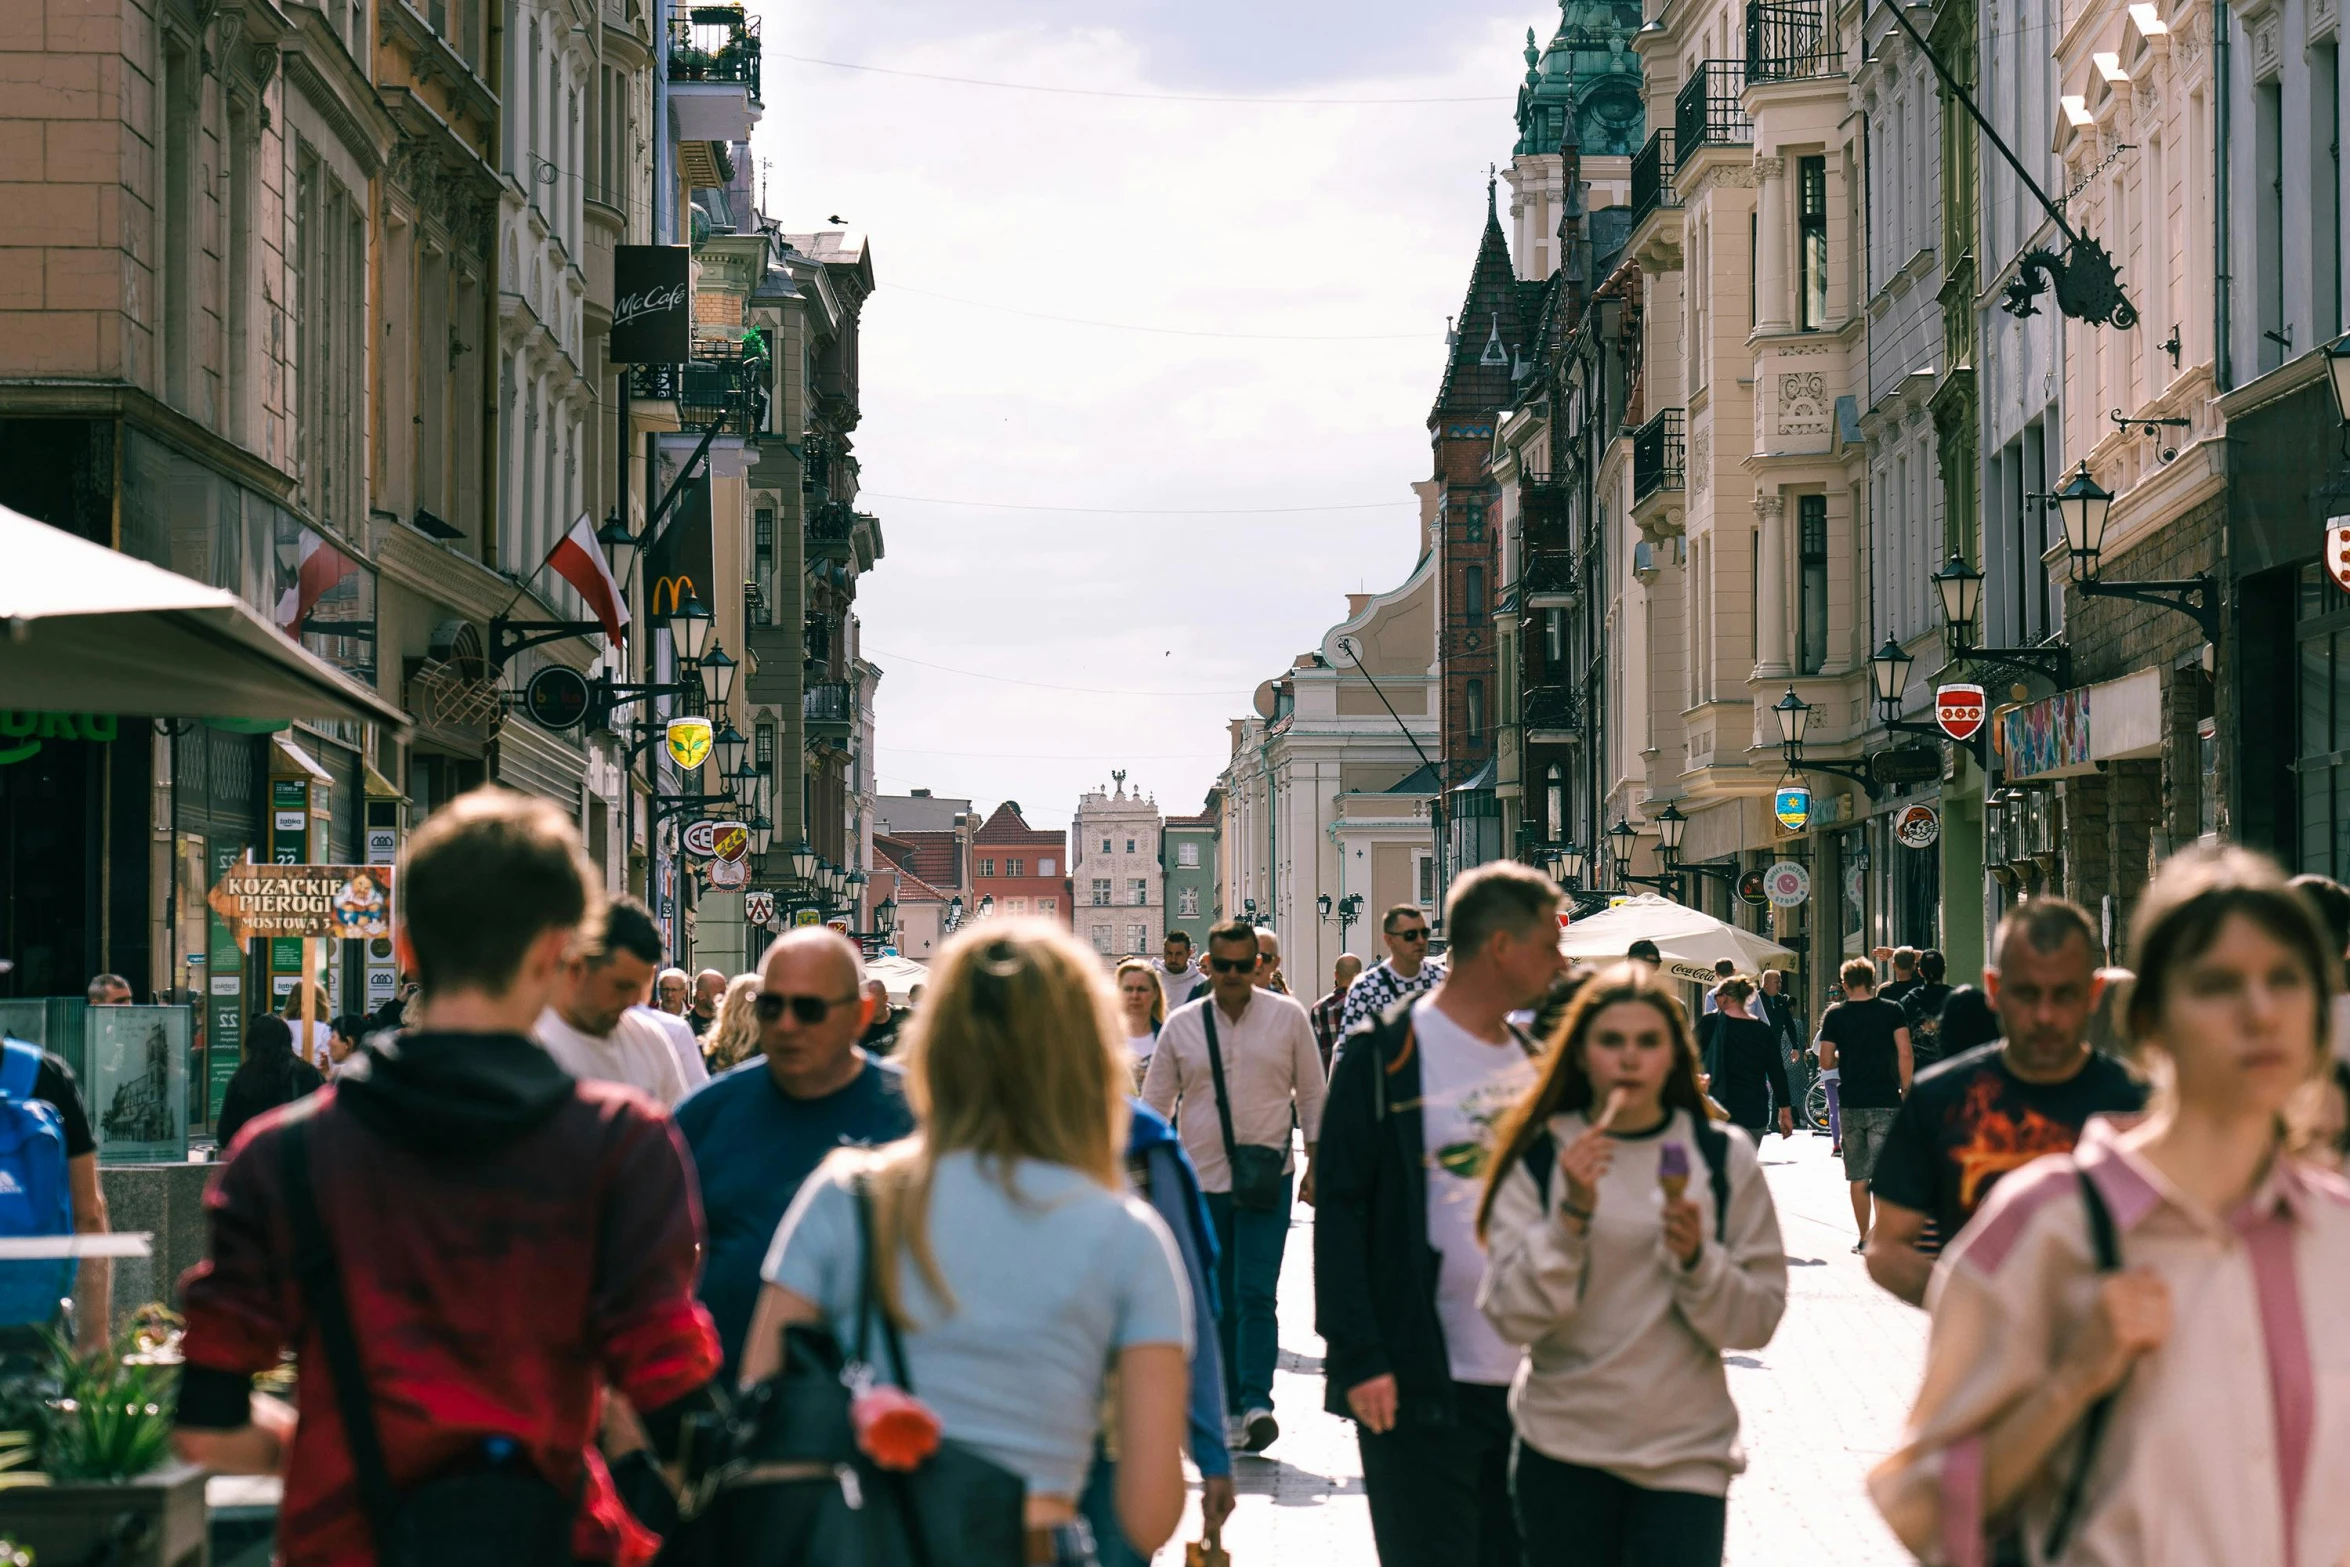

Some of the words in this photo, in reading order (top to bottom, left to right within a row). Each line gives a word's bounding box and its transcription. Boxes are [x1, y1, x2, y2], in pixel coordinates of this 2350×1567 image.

[614, 283, 686, 320] McCafé
[1767, 866, 1783, 883] SWEET
[1784, 864, 1808, 883] FACTORY
[228, 878, 343, 896] KOZACKIE
[239, 895, 331, 913] PIEROGI
[1774, 896, 1800, 905] STORE
[241, 917, 319, 930] MOSTOWA
